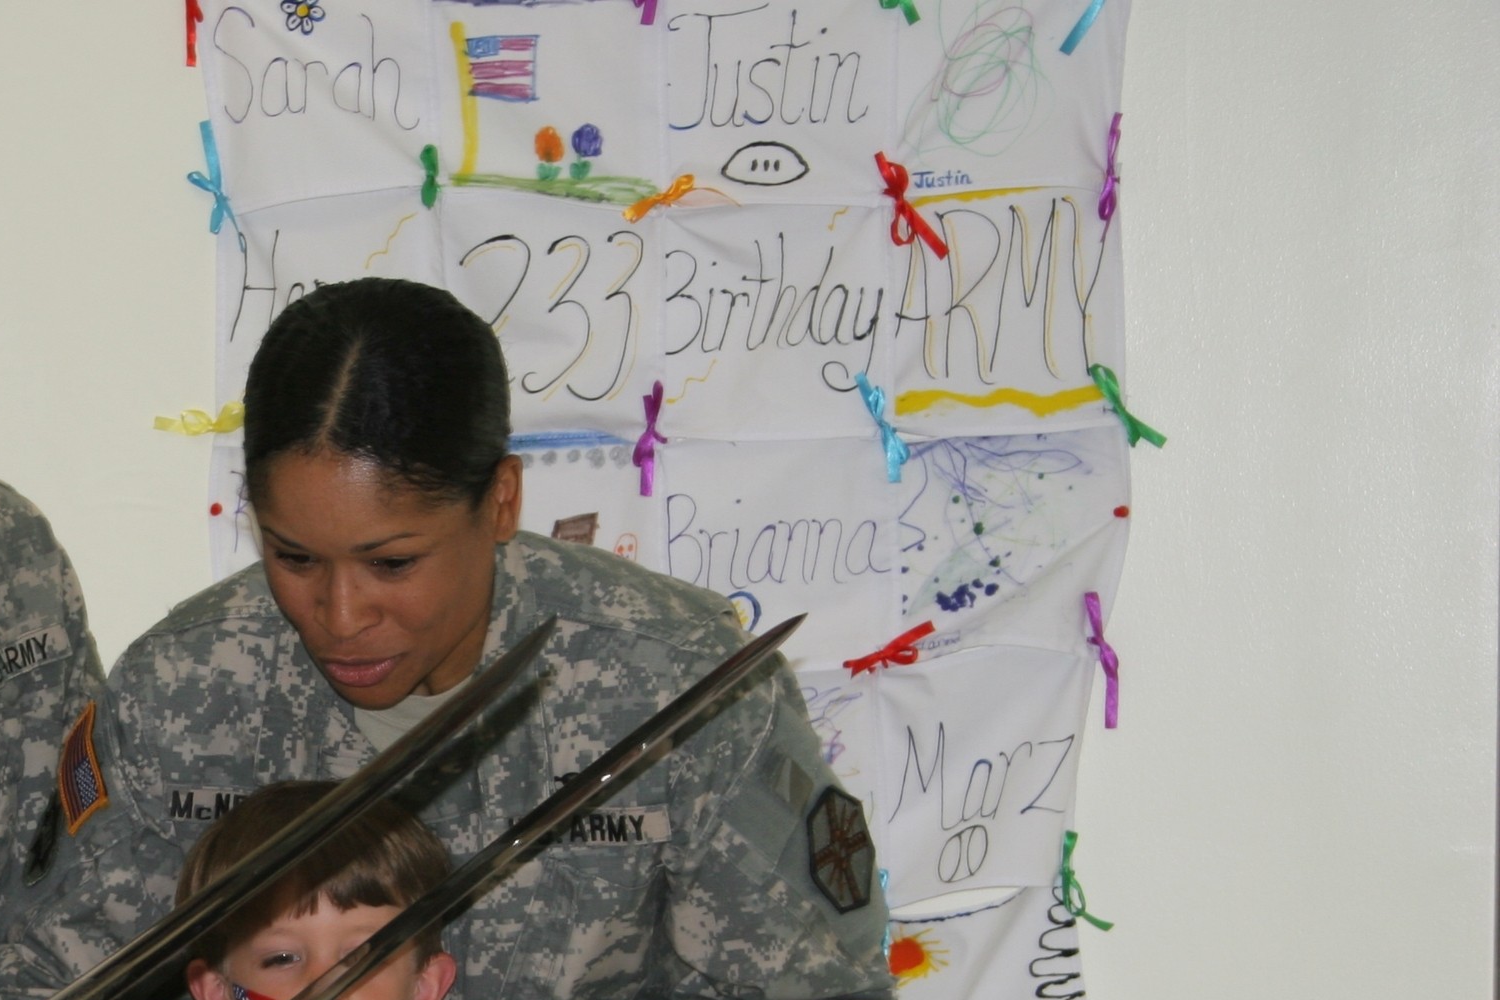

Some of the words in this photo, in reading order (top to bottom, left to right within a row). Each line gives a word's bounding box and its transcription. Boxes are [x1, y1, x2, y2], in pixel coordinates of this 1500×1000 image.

[213, 7, 421, 130] Sarah
[668, 3, 869, 130] Justin
[912, 169, 973, 189] Justin
[459, 231, 643, 402] 233
[665, 231, 884, 392] Birthday
[895, 197, 1107, 386] ARMY
[666, 494, 892, 590] Brianna
[569, 813, 646, 843] ARMY
